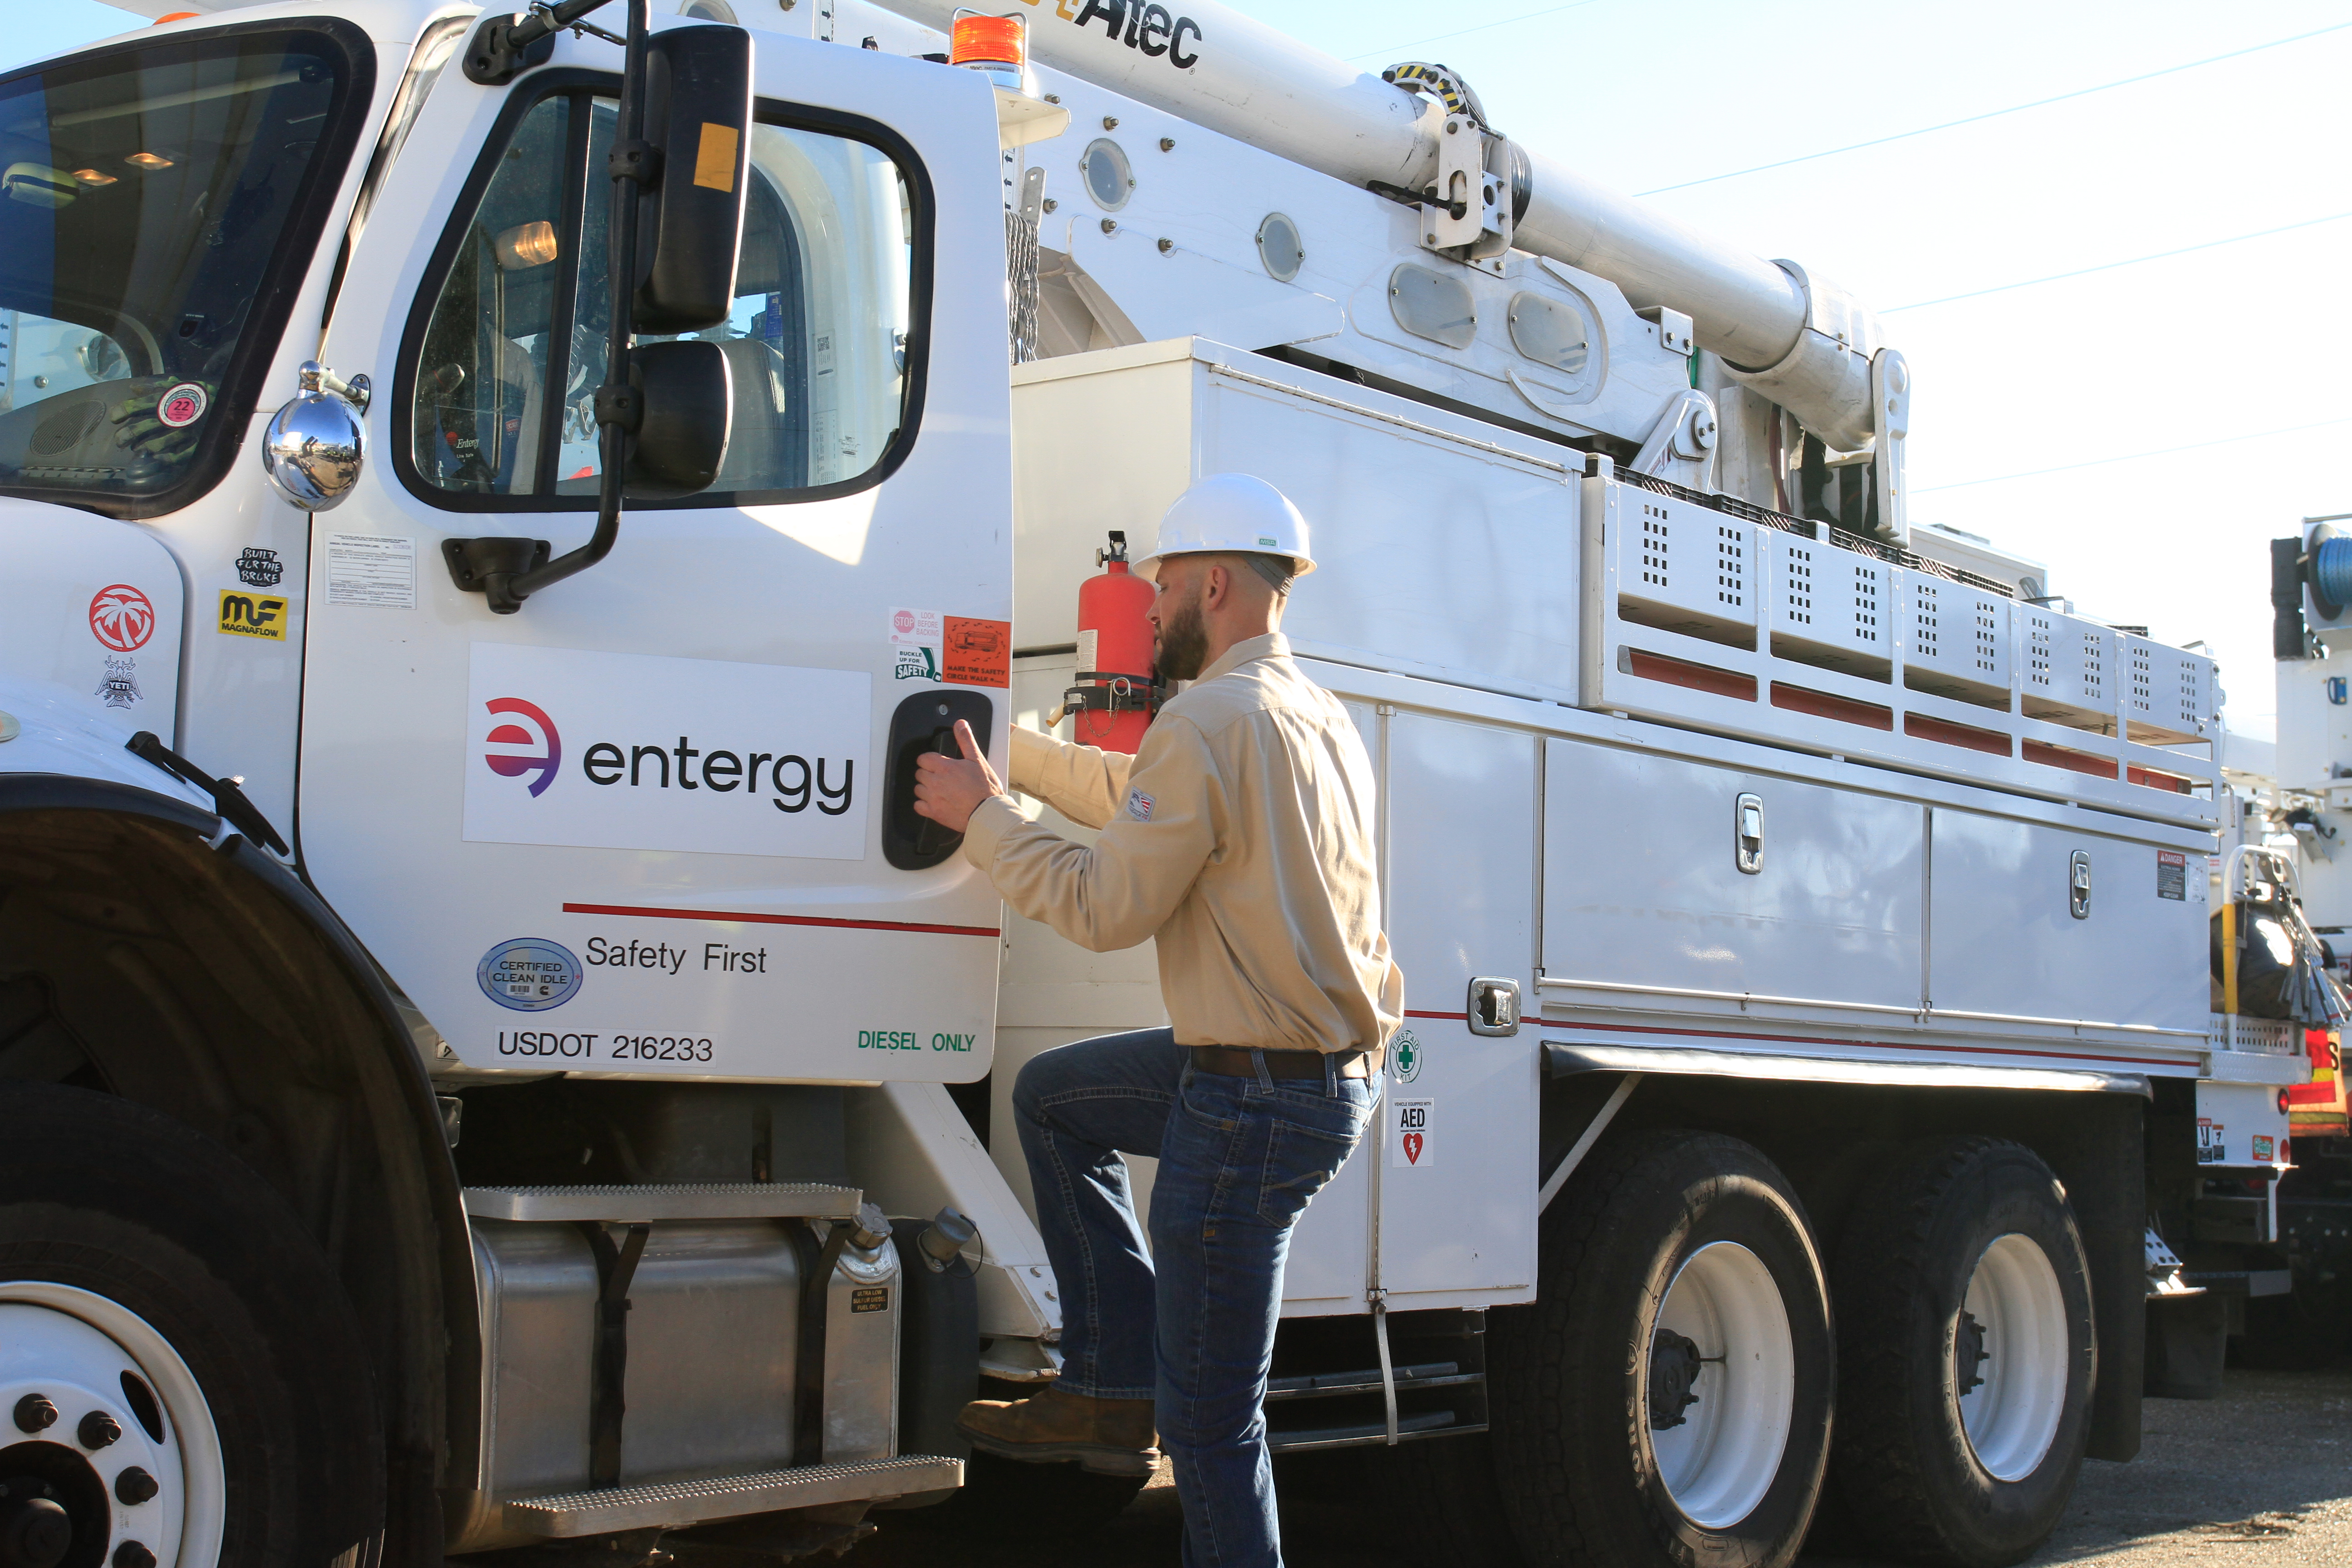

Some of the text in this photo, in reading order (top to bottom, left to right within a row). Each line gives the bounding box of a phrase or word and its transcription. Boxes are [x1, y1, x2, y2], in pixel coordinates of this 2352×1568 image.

[174, 401, 190, 411] 22
[244, 549, 275, 559] BUILT
[261, 561, 281, 572] THE
[241, 570, 278, 583] BROKE
[895, 616, 914, 627] STOP
[917, 620, 938, 628] BEFORE
[222, 623, 278, 637] MAGNAFLOW
[916, 628, 939, 637] BACKING
[897, 665, 928, 679] SAFETY
[109, 681, 130, 690] YETI
[584, 735, 853, 815] entergy
[2165, 853, 2183, 864] DANGER
[586, 937, 767, 975] Safety First
[500, 961, 562, 972] CERTIFIED
[492, 972, 568, 984] CLEAN IDLE
[498, 1031, 714, 1062] USDOT 216233
[858, 1031, 975, 1053] DIESEL ONLY
[1392, 1033, 1419, 1050] FIRST AID
[1400, 1073, 1411, 1081] KIT
[1400, 1108, 1425, 1127] AED
